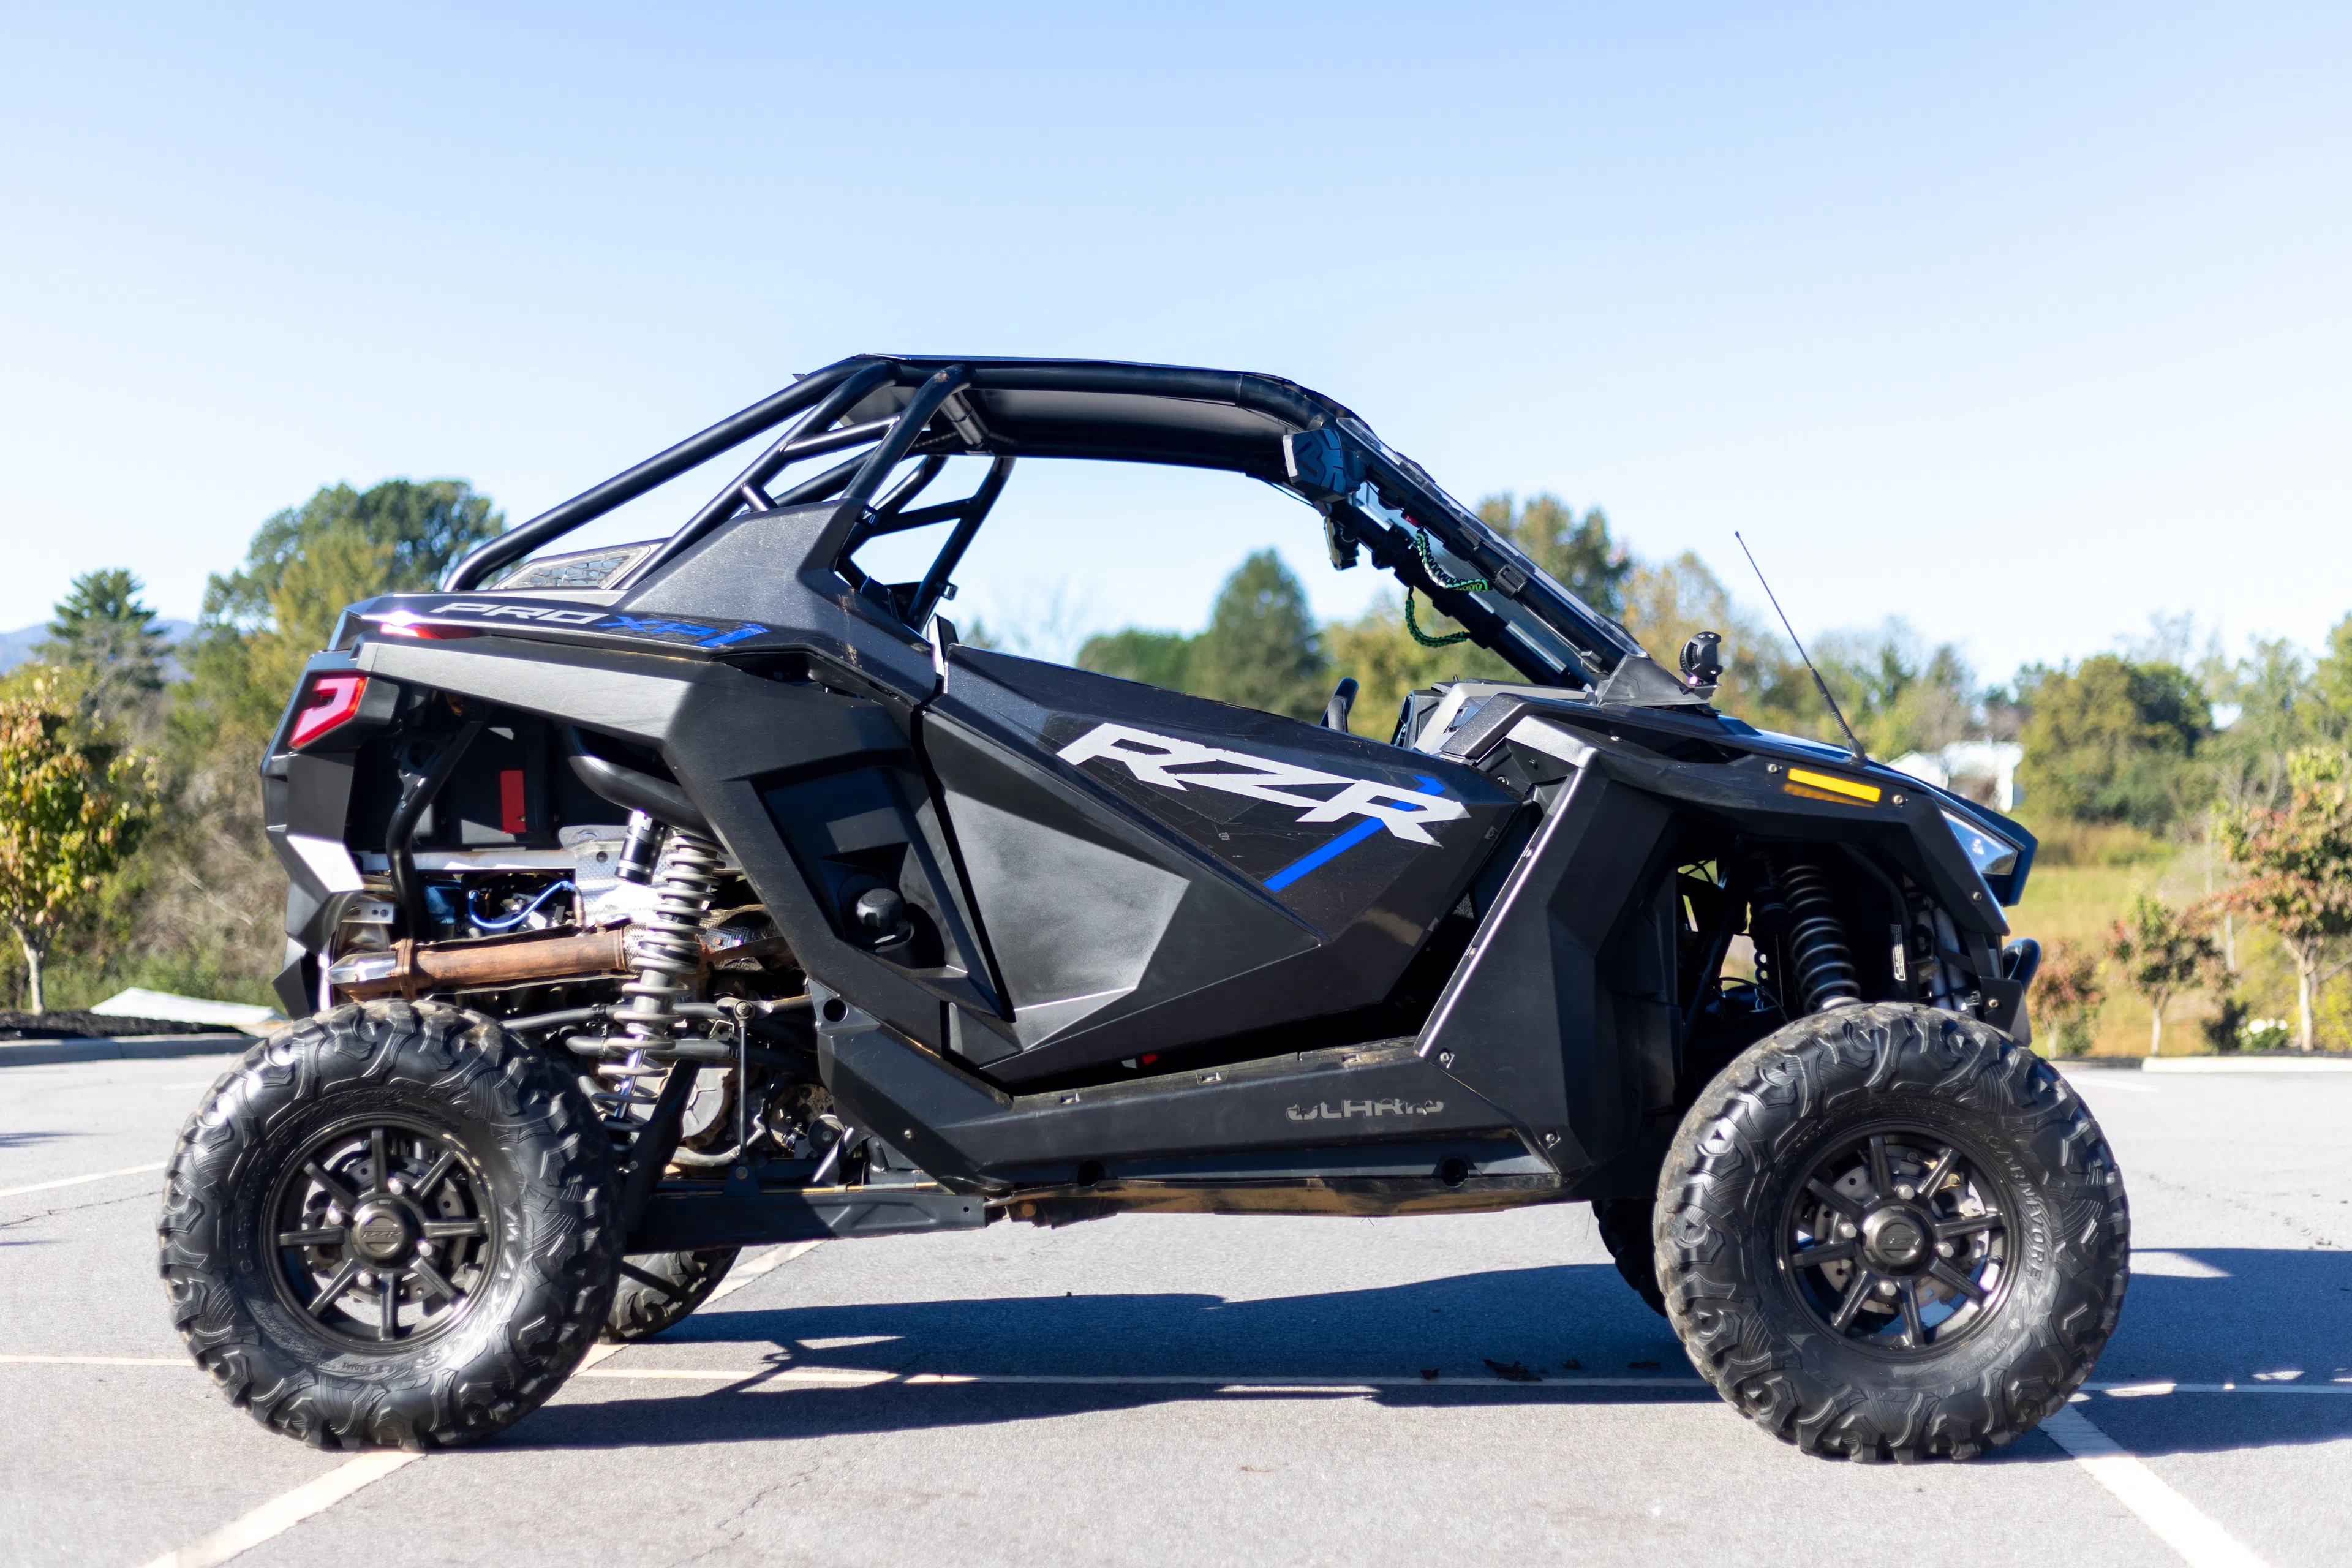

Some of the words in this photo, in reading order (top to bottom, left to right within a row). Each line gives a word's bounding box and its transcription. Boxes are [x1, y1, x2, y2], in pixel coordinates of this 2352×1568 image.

[429, 602, 609, 624] PRO
[592, 615, 718, 636] XP
[1057, 722, 1471, 848] RZR
[1988, 1136, 2045, 1281] CARNIVORE
